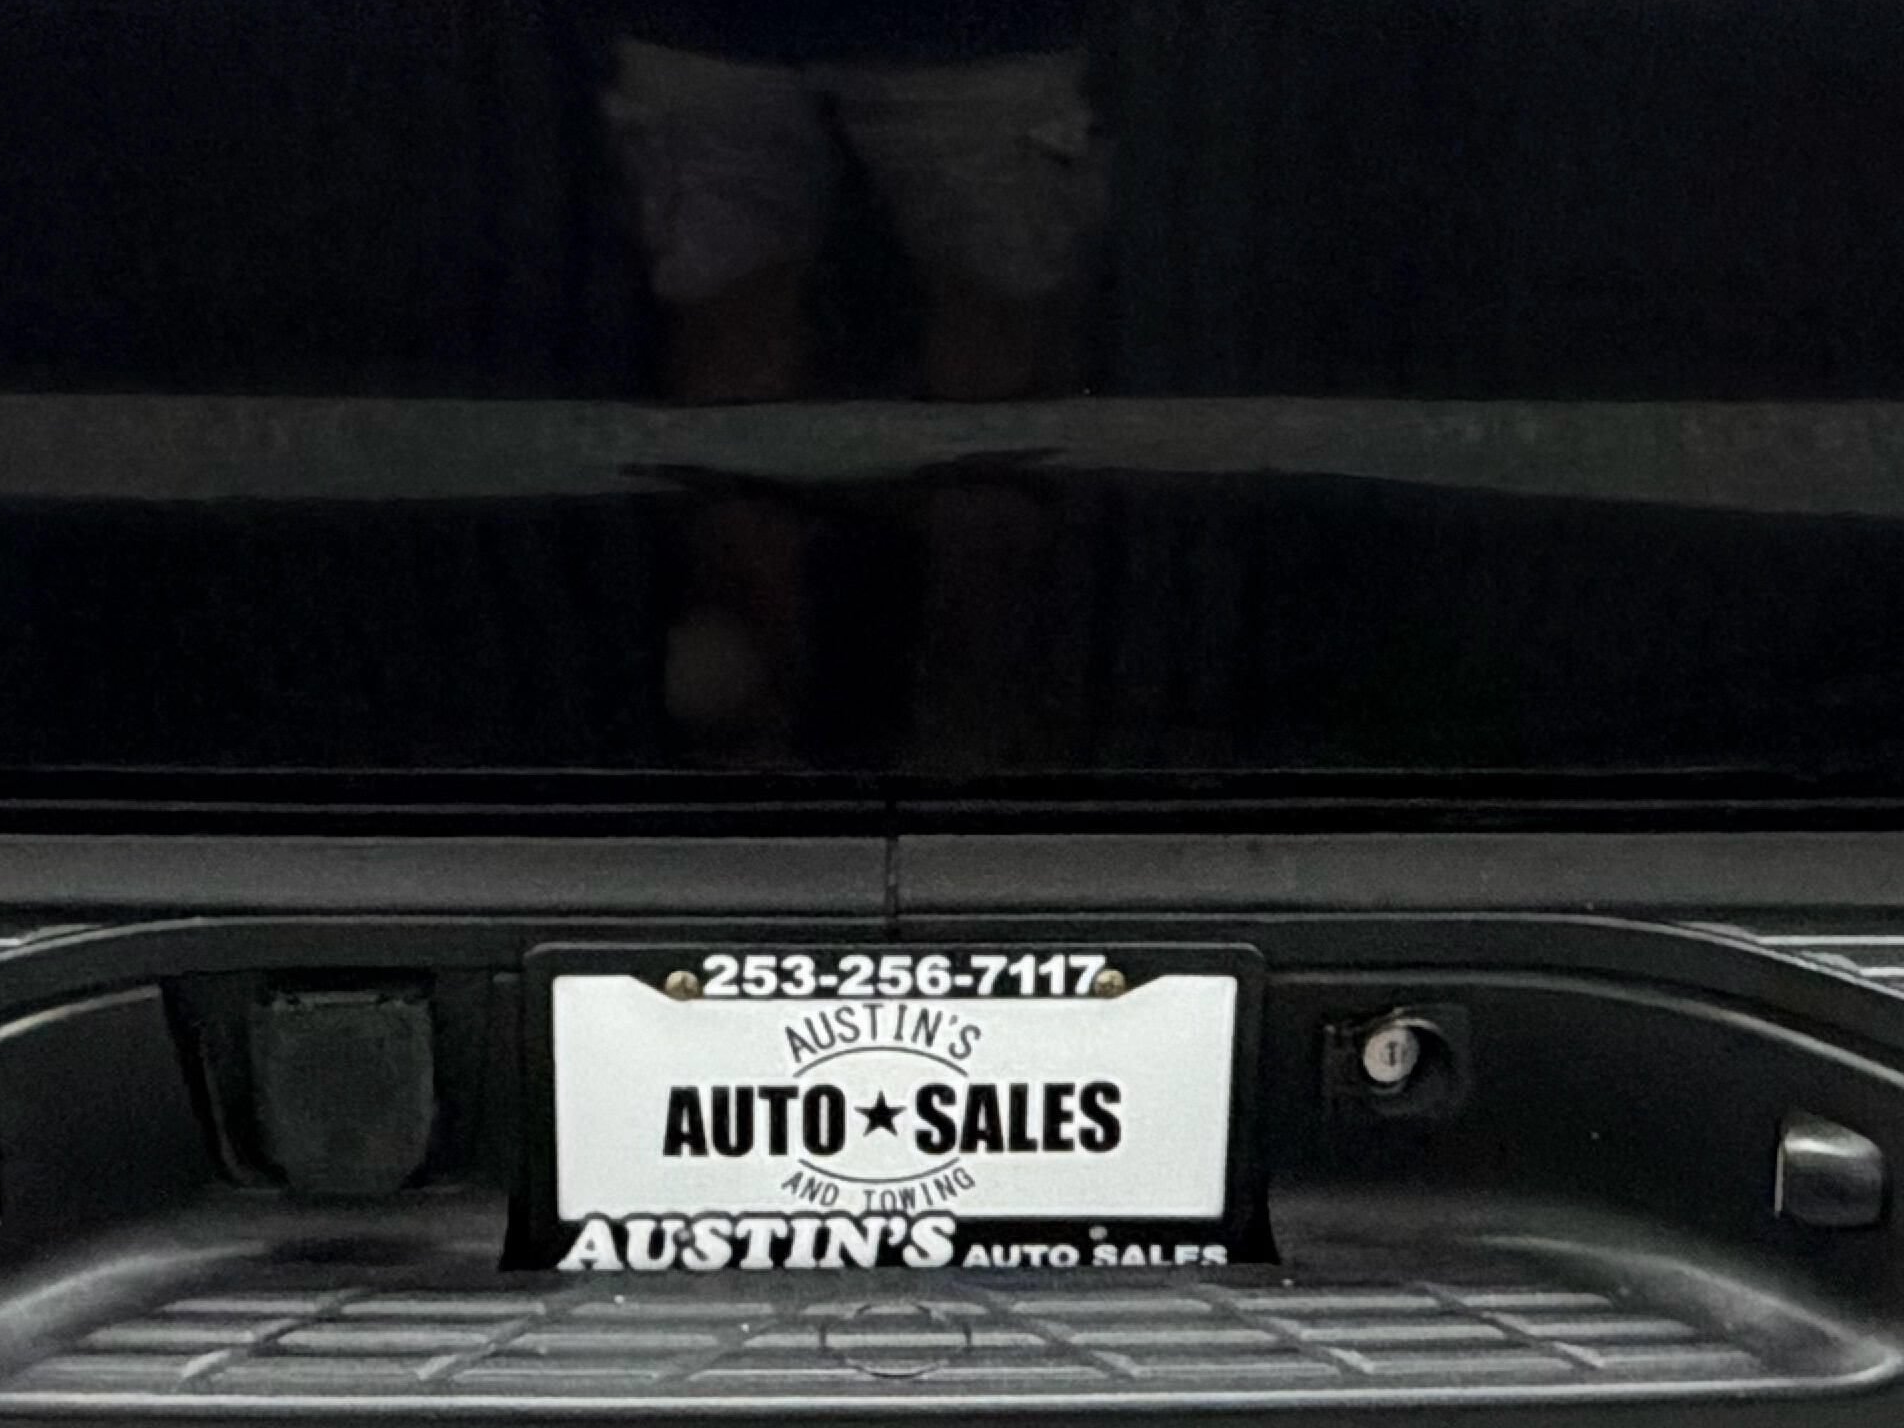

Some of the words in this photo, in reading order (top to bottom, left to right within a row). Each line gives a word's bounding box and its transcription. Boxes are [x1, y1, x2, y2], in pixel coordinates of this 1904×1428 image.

[702, 954, 1106, 997] 253-256-7117
[785, 1003, 982, 1064] AUSTIN'S
[662, 1085, 846, 1157] AUTO
[914, 1082, 1122, 1154] SALES
[781, 1171, 840, 1207] AND
[863, 1167, 976, 1212] TOWING
[557, 1216, 958, 1269] AUSTIN'S
[962, 1243, 1079, 1267] AUTO
[1093, 1243, 1228, 1267] SALES
